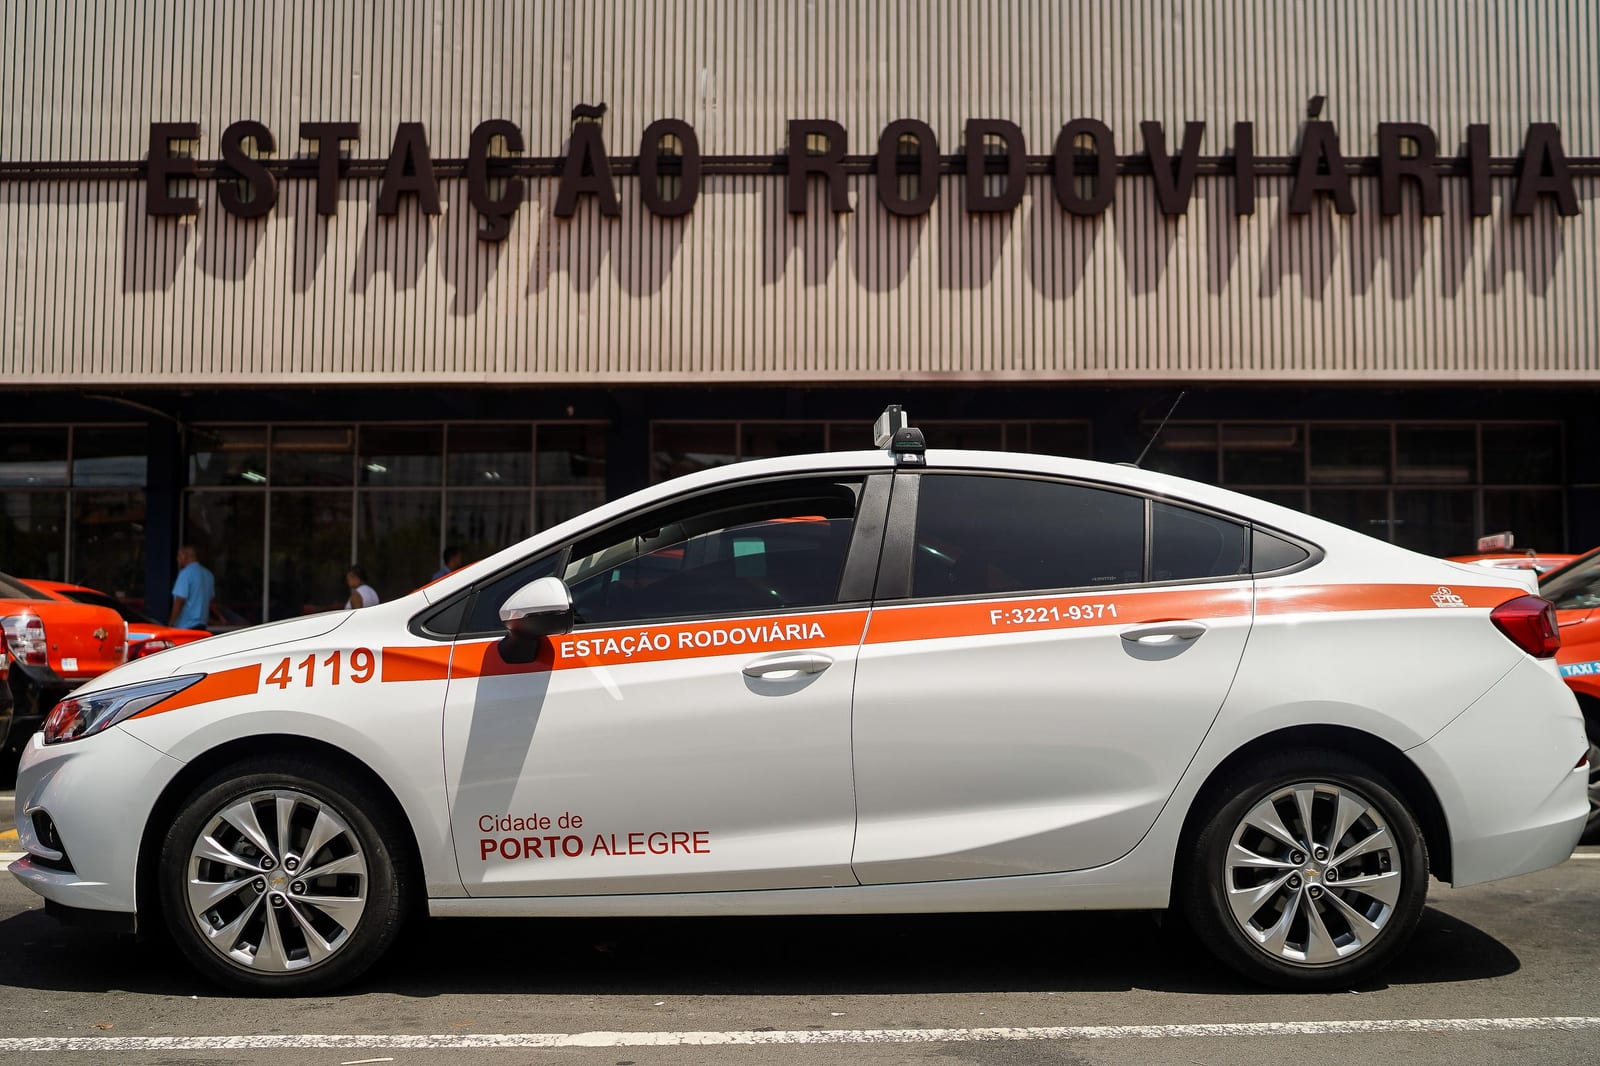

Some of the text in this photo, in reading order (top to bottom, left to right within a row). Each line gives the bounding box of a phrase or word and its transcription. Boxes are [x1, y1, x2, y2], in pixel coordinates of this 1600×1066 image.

[146, 96, 1580, 242] ESTAÇÃO RODOVIÁRIA
[990, 603, 1118, 625] F:3221-9371
[560, 622, 825, 658] ESTAÇÃO RODOVIÁRIA
[265, 647, 375, 689] 4119
[1563, 663, 1593, 677] TAXI
[478, 811, 583, 832] Cidade de
[480, 831, 711, 861] PORTO ALEGRE
